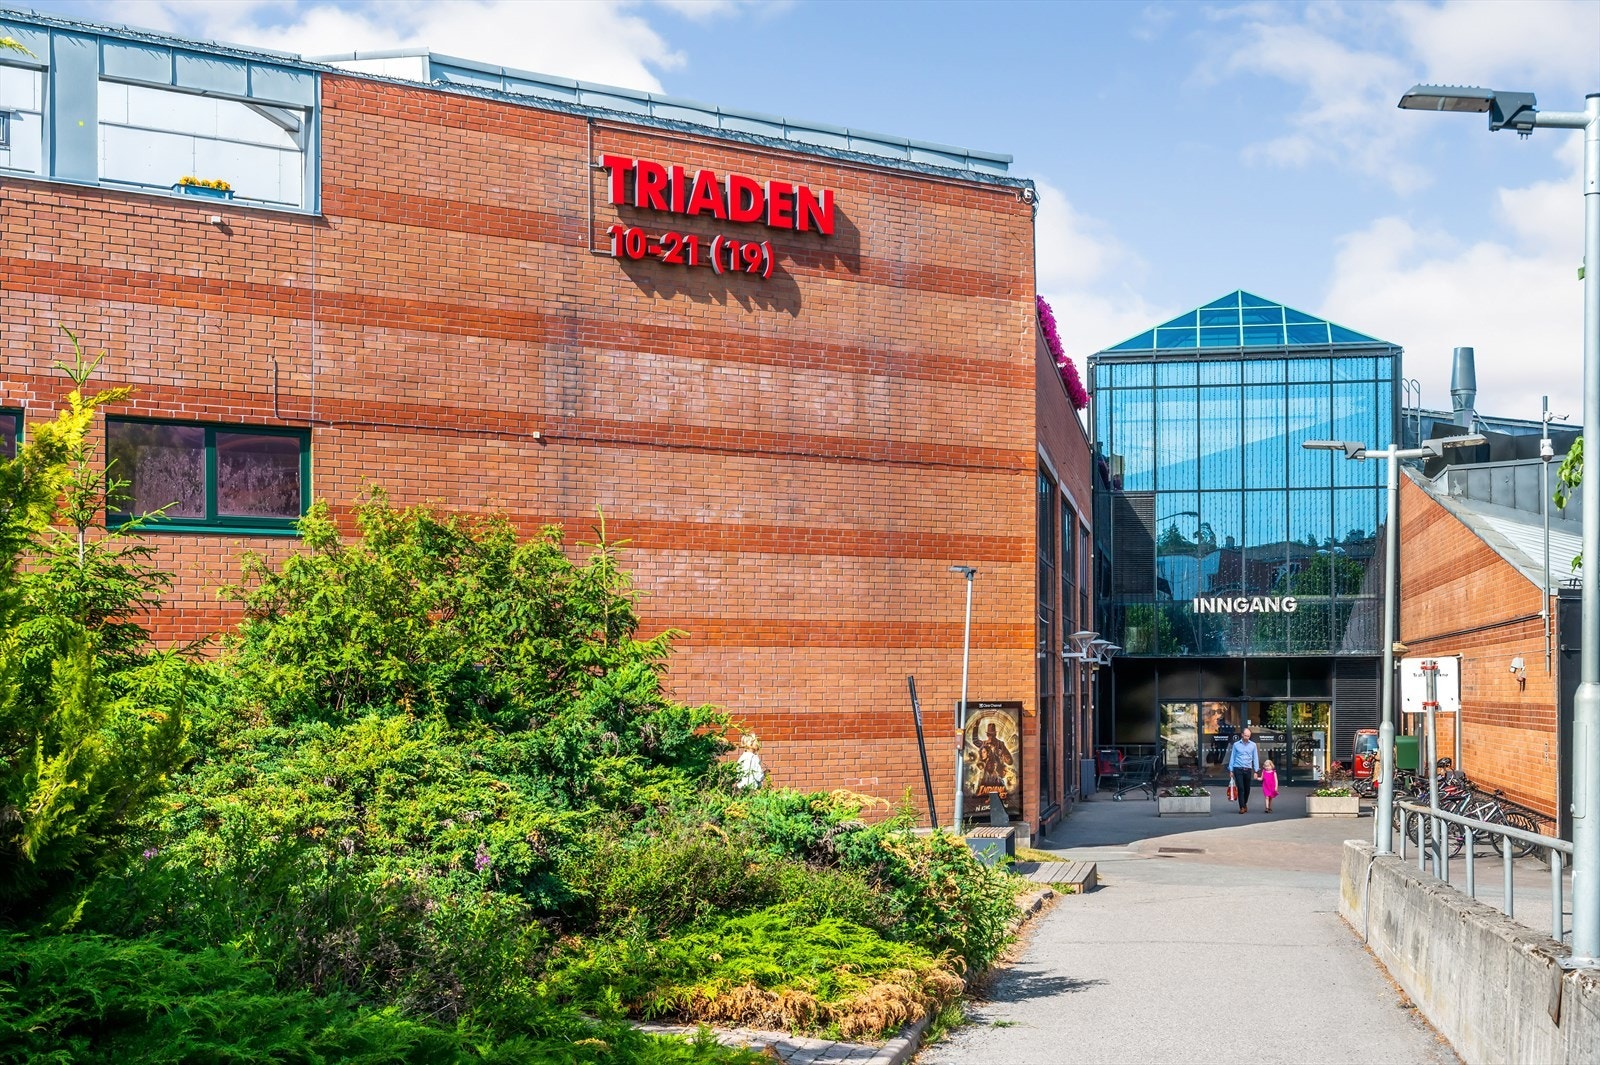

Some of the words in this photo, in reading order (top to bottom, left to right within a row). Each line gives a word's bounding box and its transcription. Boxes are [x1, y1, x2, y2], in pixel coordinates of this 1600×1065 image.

[599, 154, 834, 235] TRIADEN
[607, 225, 698, 266] 10-21
[710, 234, 775, 279] (19)
[1193, 597, 1298, 613] INNGANG
